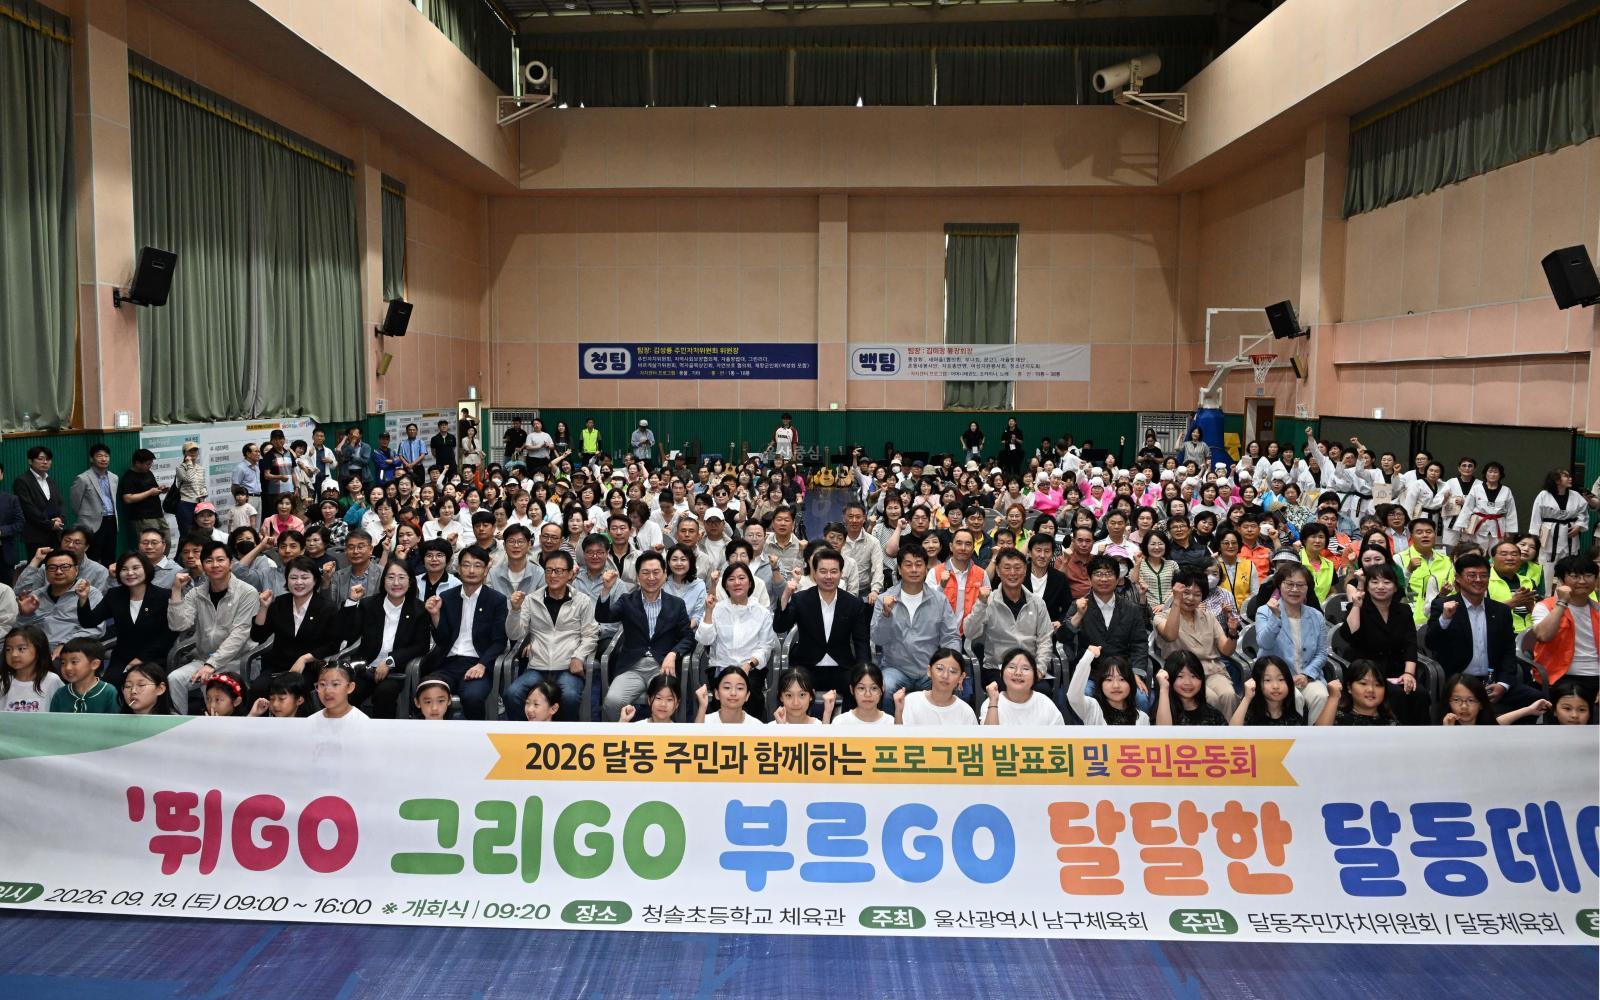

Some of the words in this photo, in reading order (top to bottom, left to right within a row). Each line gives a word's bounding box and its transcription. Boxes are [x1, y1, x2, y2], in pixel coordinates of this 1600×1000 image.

[590, 351, 626, 371] 청팀
[719, 347, 739, 355] 위원장
[859, 352, 895, 372] 백팀
[525, 742, 595, 771] 2026
[603, 740, 657, 774] 달동
[663, 741, 749, 774] 주민과
[754, 741, 866, 775] 함께하는
[873, 743, 984, 777] 프로그램
[992, 743, 1074, 777] 발표회
[1083, 744, 1110, 777] 및
[1116, 743, 1257, 778] 동민운동회
[390, 795, 687, 884] 그리GO
[719, 799, 1016, 892] 부르GO
[1047, 799, 1294, 896] 달달한
[1321, 800, 1599, 897] 달동데
[44, 887, 106, 904] 2026.
[110, 890, 143, 906] 09.
[150, 892, 176, 907] 19.
[182, 892, 222, 911] (토)
[223, 894, 289, 912] 09:00
[314, 897, 372, 915] 16:00
[401, 899, 470, 919] 개회식
[482, 901, 551, 921] 09:20
[575, 904, 618, 923] 장소
[642, 904, 774, 926] 청솔초등학교
[779, 907, 847, 927] 체육관
[871, 908, 914, 928] 주최
[933, 909, 1038, 930] 울산광역시
[1042, 910, 1149, 931] 남구체육회
[1181, 911, 1225, 933] 주관
[1247, 911, 1440, 935] 달동주민자치위원회
[1454, 912, 1564, 935] 달동체육회
